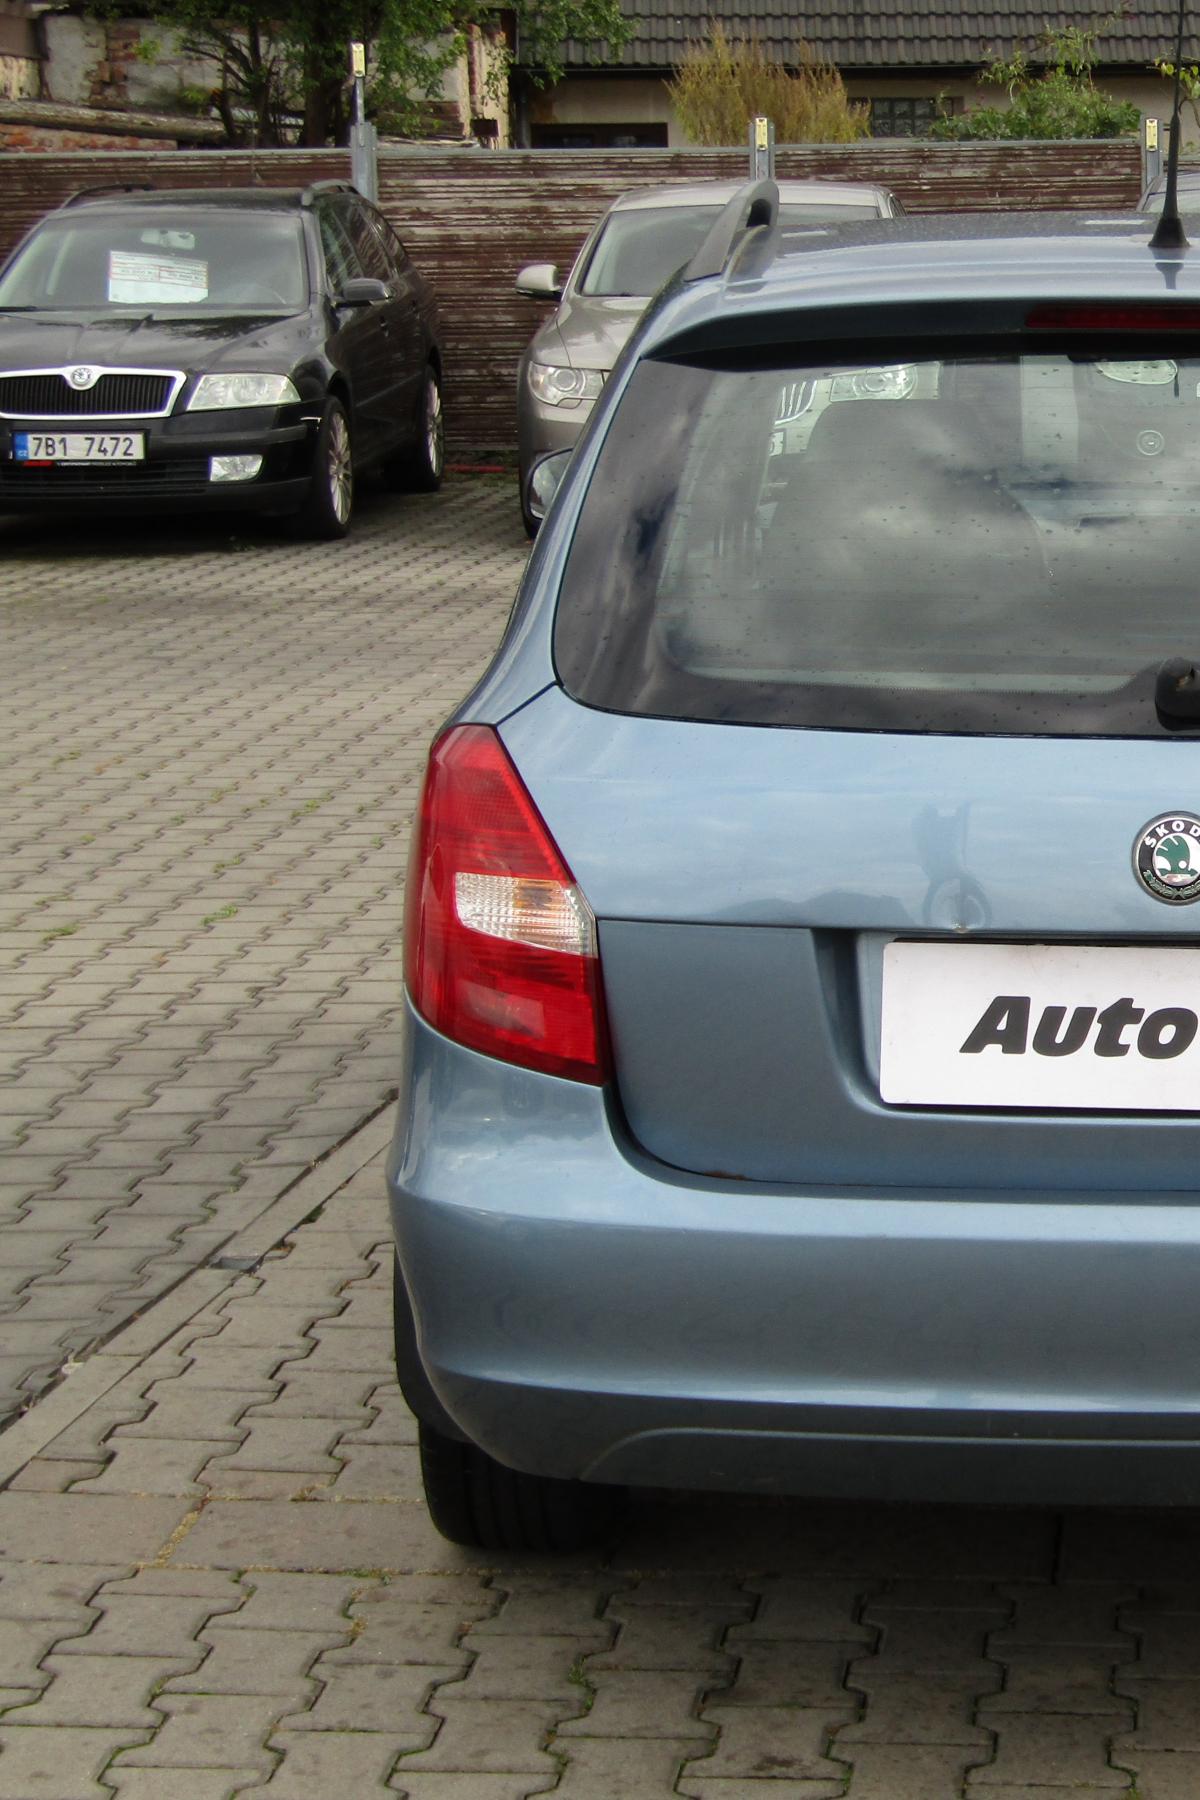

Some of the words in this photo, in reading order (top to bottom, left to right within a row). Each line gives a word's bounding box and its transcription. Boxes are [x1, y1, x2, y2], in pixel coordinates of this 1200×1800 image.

[32, 437, 68, 457] 7B1
[84, 437, 134, 457] 7472
[959, 996, 1198, 1060] Auto
